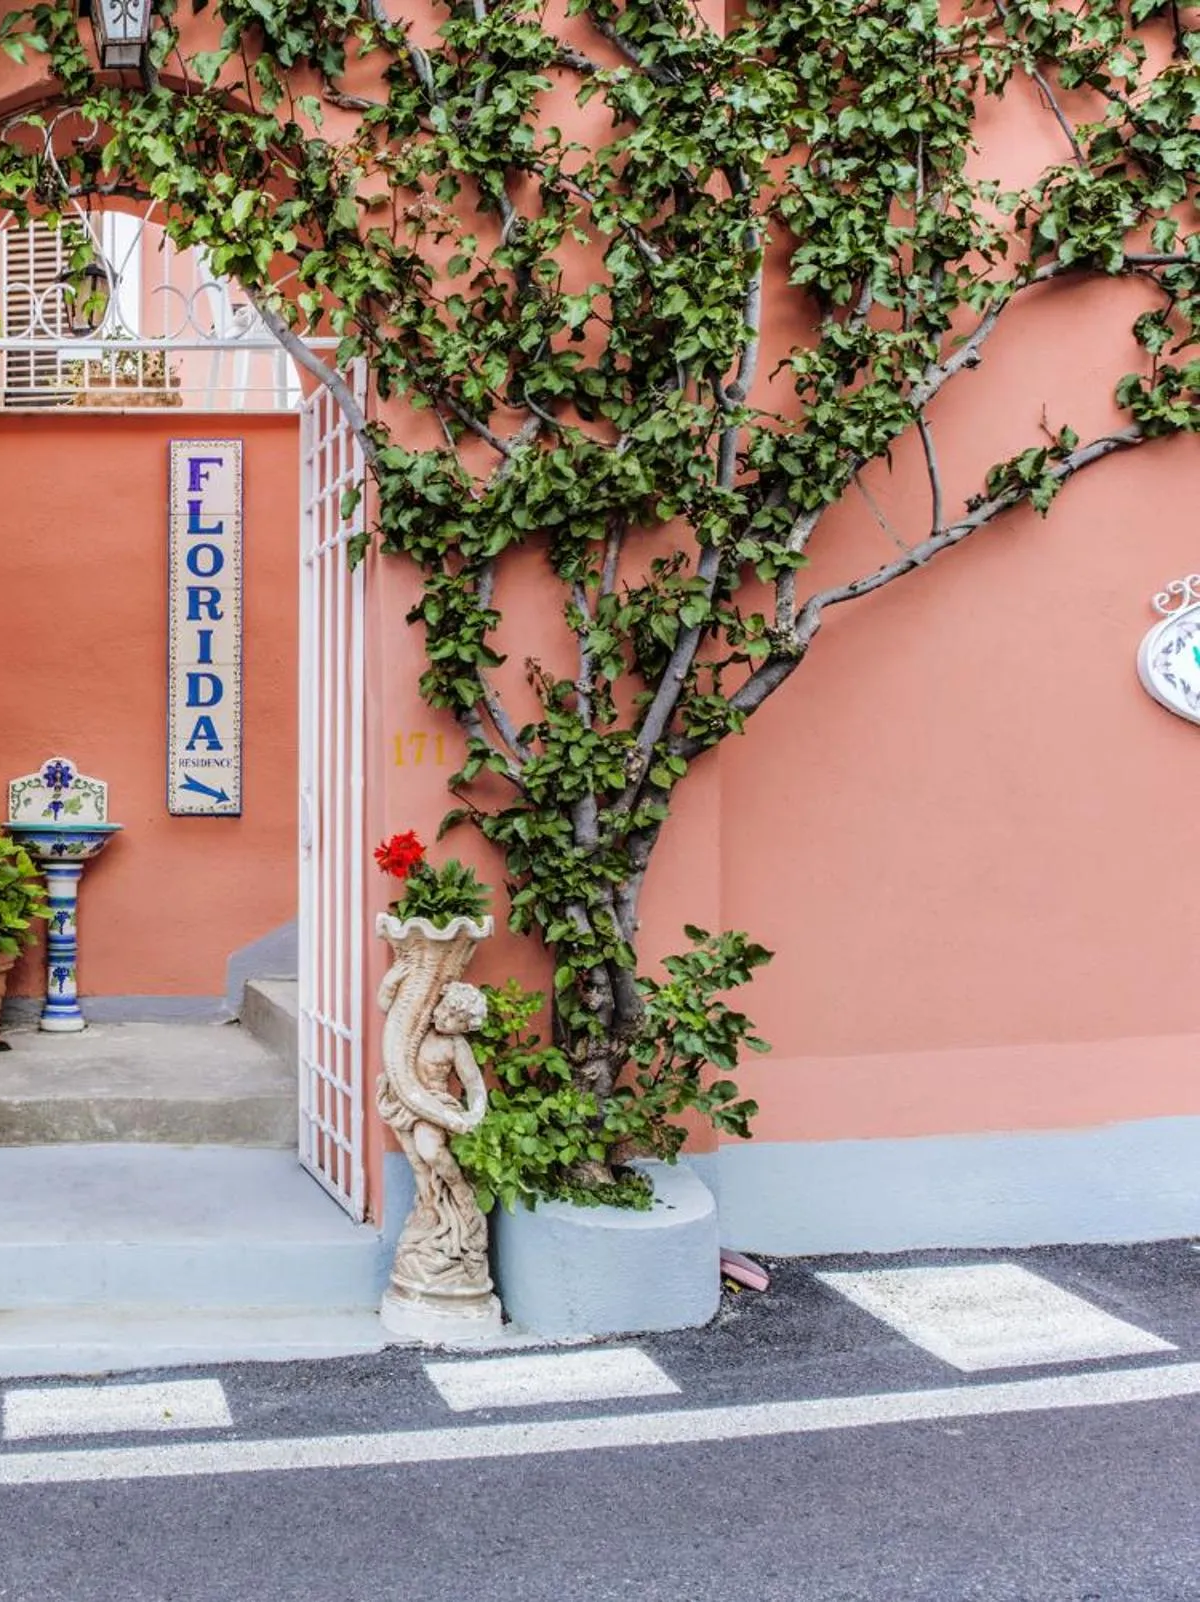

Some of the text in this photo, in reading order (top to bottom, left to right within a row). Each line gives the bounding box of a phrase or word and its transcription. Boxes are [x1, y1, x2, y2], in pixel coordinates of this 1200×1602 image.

[186, 457, 224, 751] FLORIDA
[178, 758, 233, 768] RESIDENCE
[393, 729, 445, 767] 171
